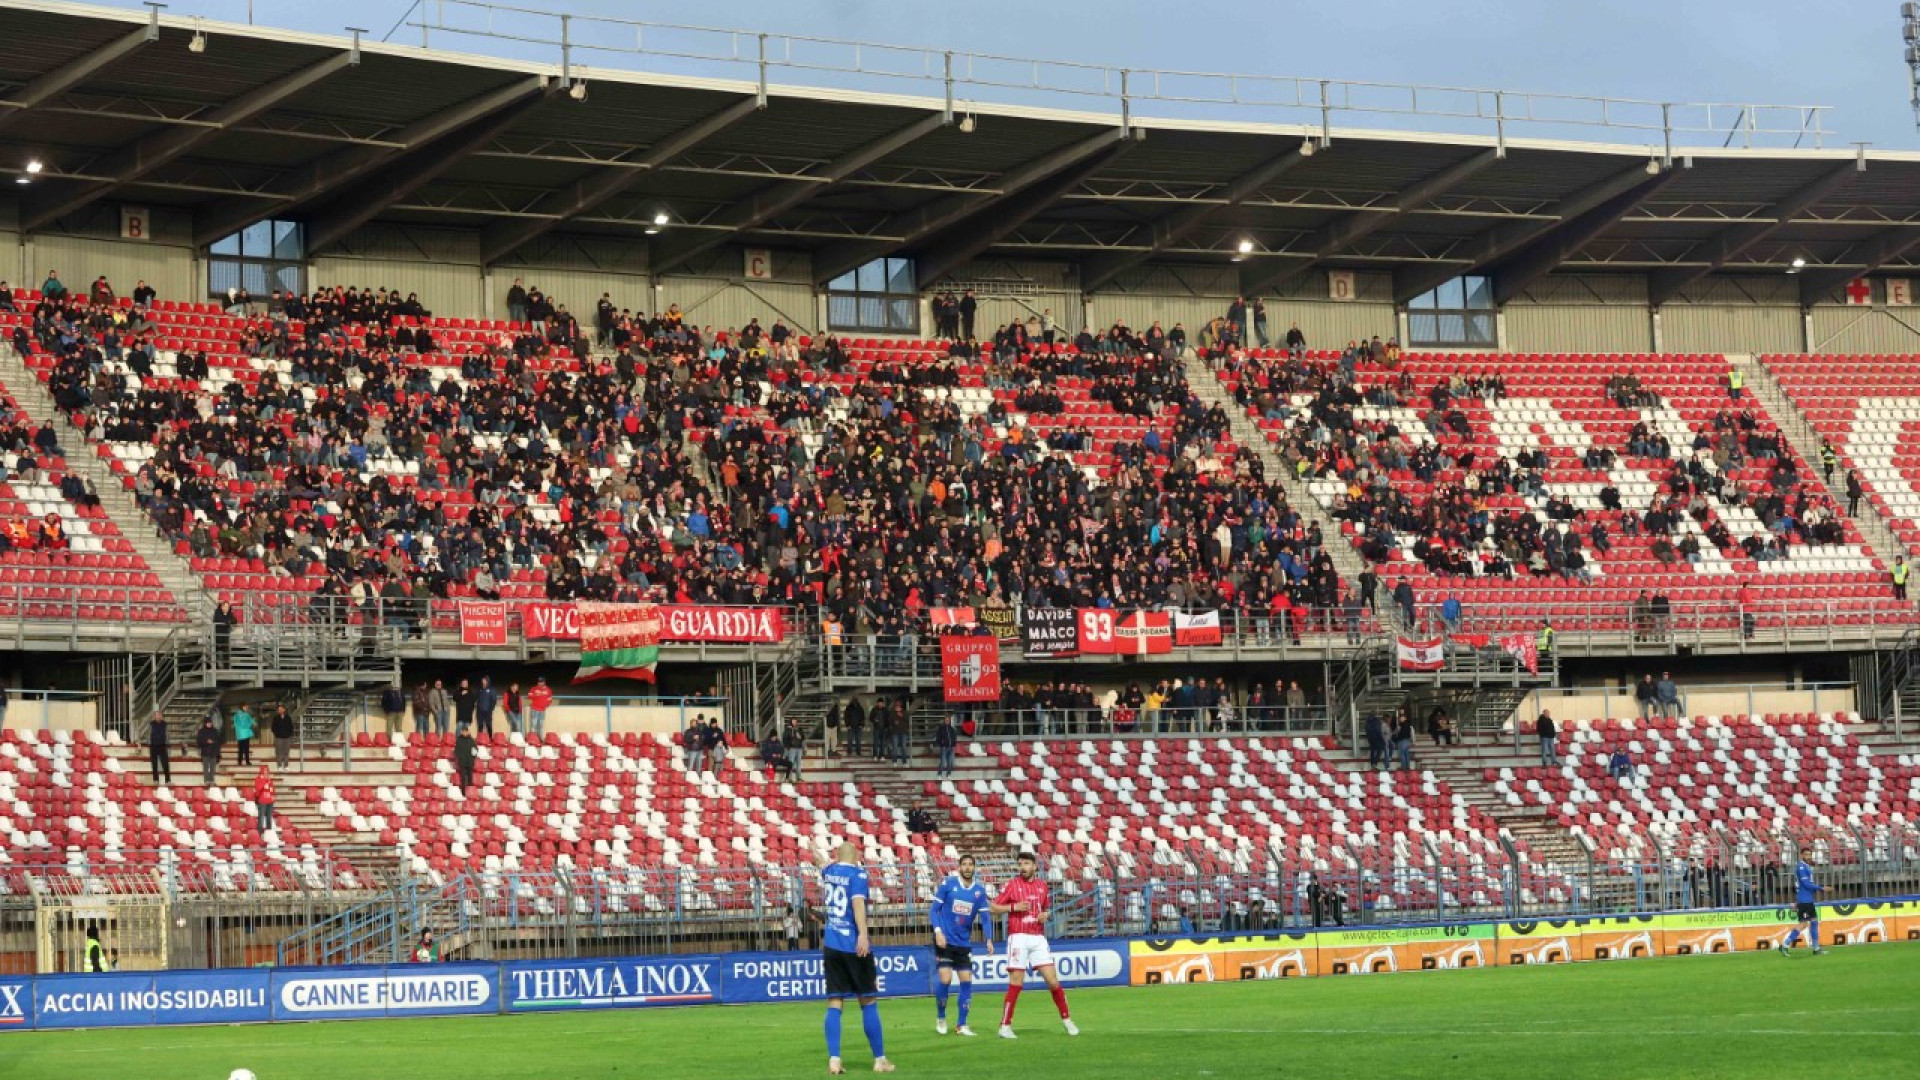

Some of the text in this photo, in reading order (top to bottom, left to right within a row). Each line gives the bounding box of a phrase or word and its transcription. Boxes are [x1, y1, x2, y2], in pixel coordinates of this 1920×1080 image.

[129, 216, 141, 237] B
[753, 258, 763, 277] C
[1894, 286, 1903, 303] E
[670, 608, 775, 638] GUARDIA
[1027, 609, 1073, 620] DAVIDE
[1028, 627, 1075, 639] MARCO
[1083, 611, 1112, 641] 93
[946, 642, 992, 653] GRUPPO
[946, 664, 997, 677] 19 92
[948, 686, 995, 697] PLACENTIA
[873, 955, 919, 974] OSA
[512, 963, 713, 1000] THEMA INOX
[43, 988, 266, 1013] ACCIAI INOSSIDABILI
[292, 980, 480, 1006] CANNE FUMARIE
